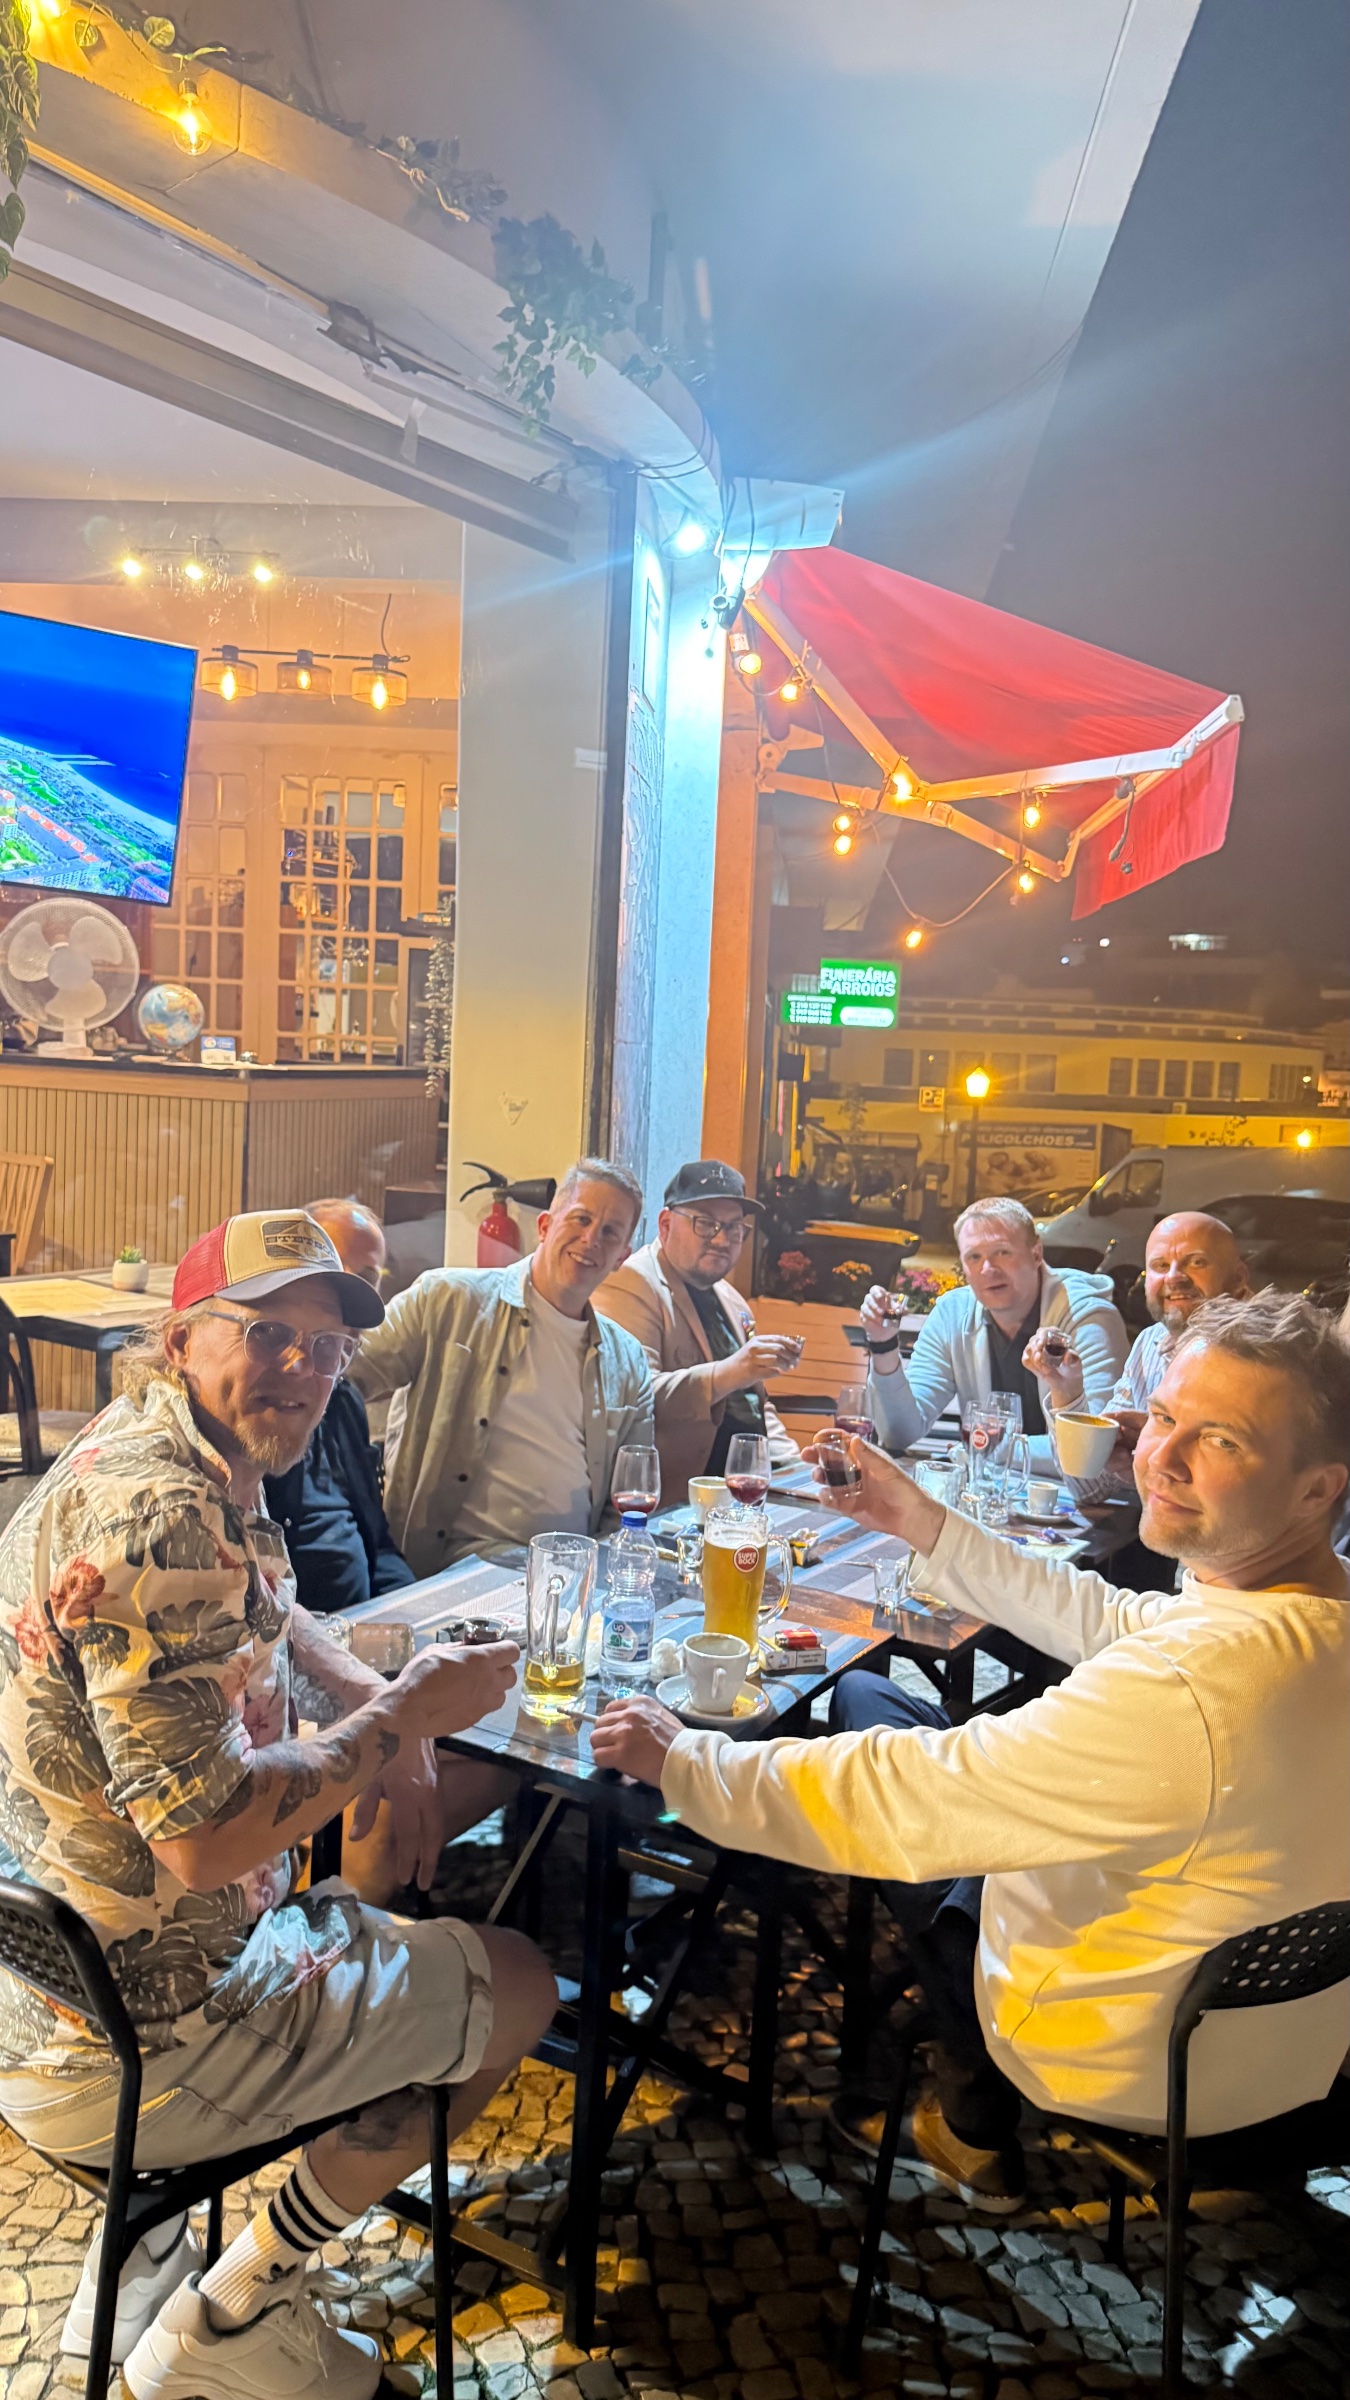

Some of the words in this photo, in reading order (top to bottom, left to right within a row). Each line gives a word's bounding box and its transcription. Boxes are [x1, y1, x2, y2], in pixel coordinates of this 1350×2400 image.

[820, 967, 896, 984] FUNERÁRIA
[821, 982, 833, 990] DE
[830, 981, 896, 997] ARROIOS
